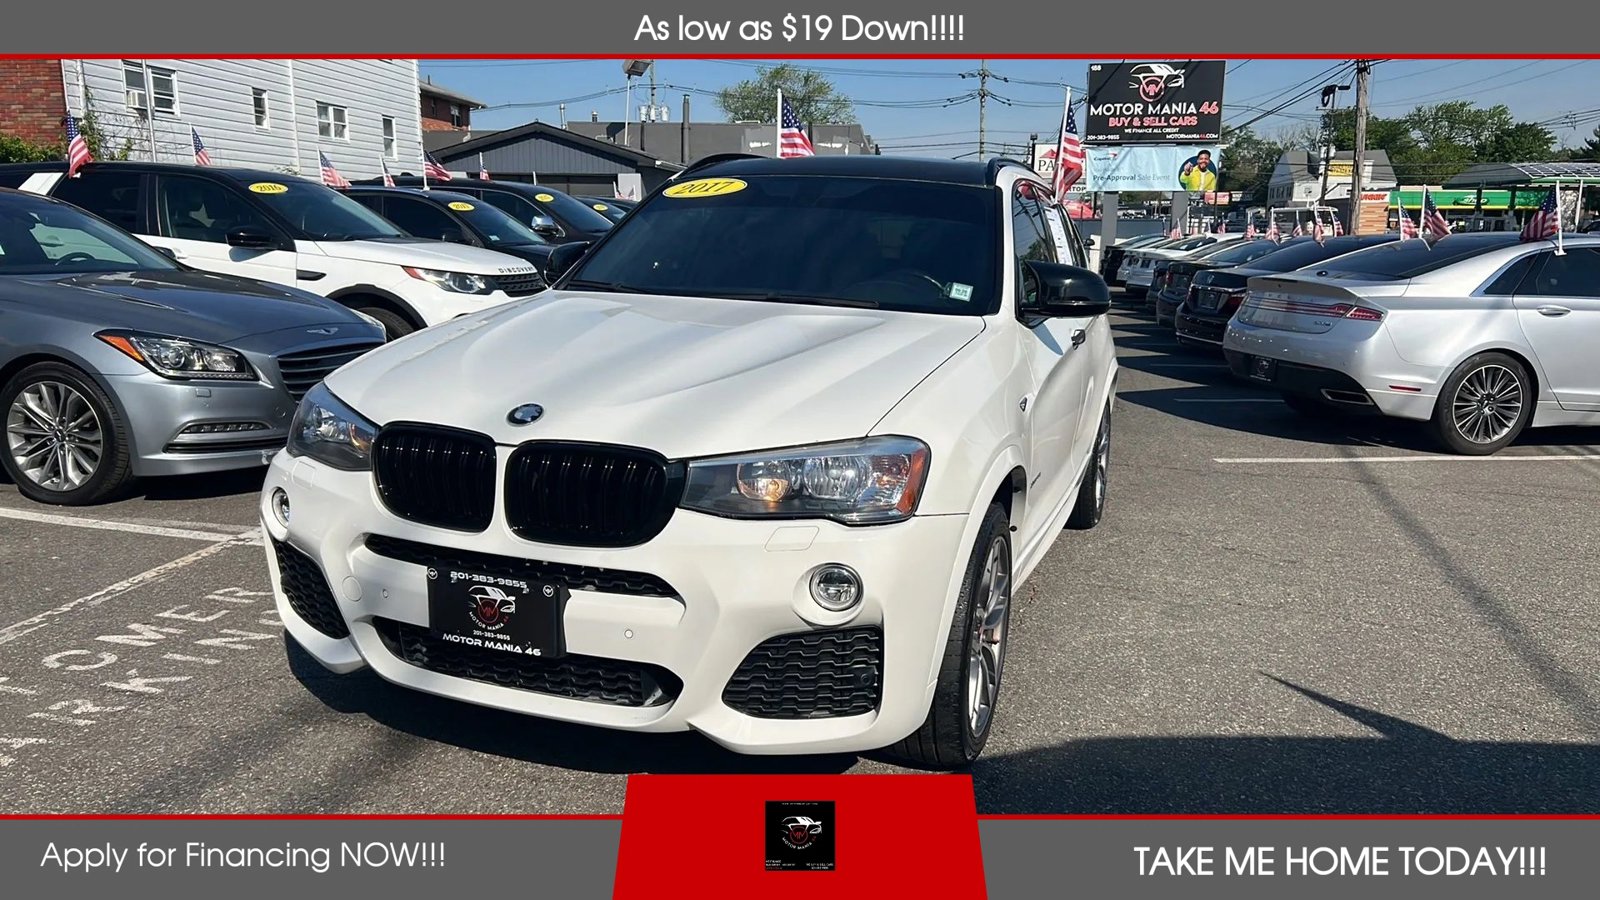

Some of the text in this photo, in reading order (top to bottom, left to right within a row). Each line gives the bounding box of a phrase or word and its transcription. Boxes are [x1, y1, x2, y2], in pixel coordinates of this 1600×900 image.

[1090, 101, 1219, 116] MOTOR MANIA 46
[1109, 116, 1198, 127] BUY & SELL CARS
[673, 181, 735, 195] 2017
[450, 571, 527, 589] 201-383-9855
[469, 611, 486, 629] MOTOR
[487, 622, 504, 631] MANIA
[442, 633, 541, 657] MOTOR MANIA 46
